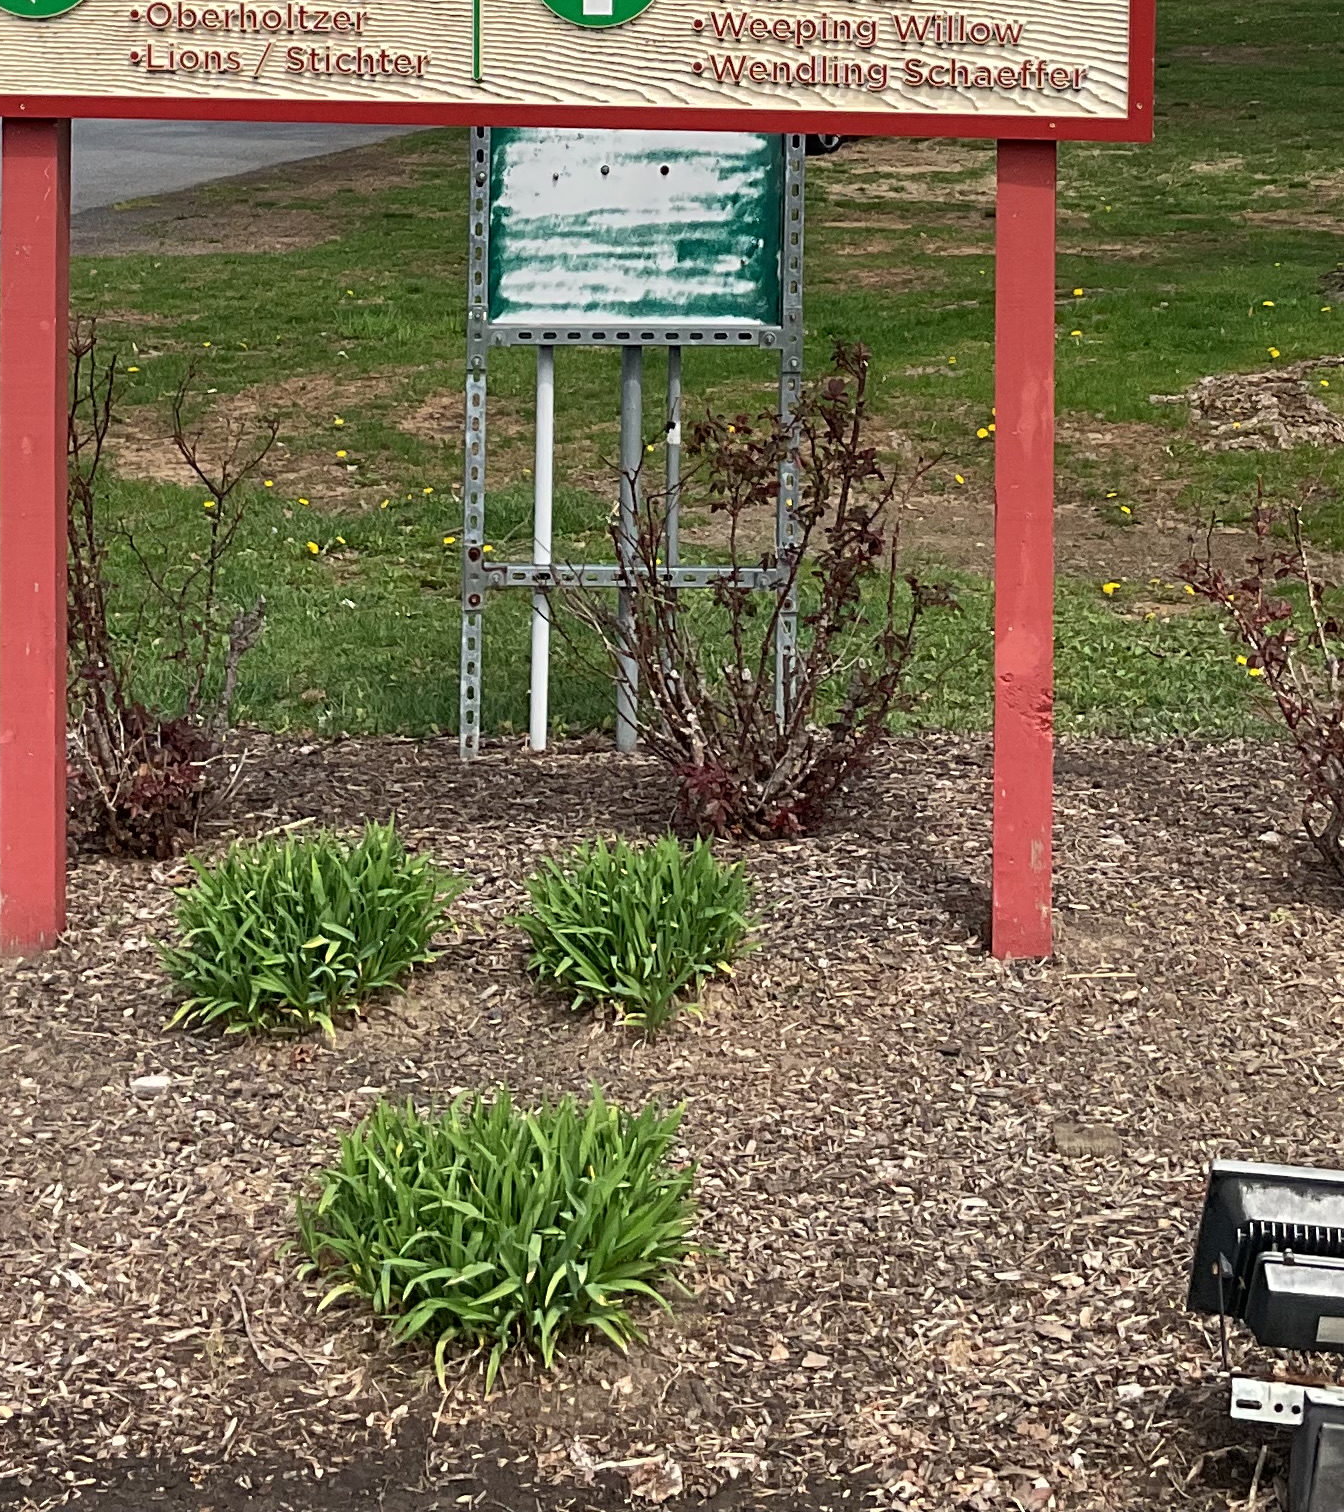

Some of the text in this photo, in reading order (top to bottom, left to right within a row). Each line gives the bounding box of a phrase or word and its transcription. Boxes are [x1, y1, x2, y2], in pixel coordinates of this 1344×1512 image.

[894, 13, 1024, 46] Willow
[286, 45, 431, 77] Stichter
[904, 56, 1088, 91] Schaeffer
